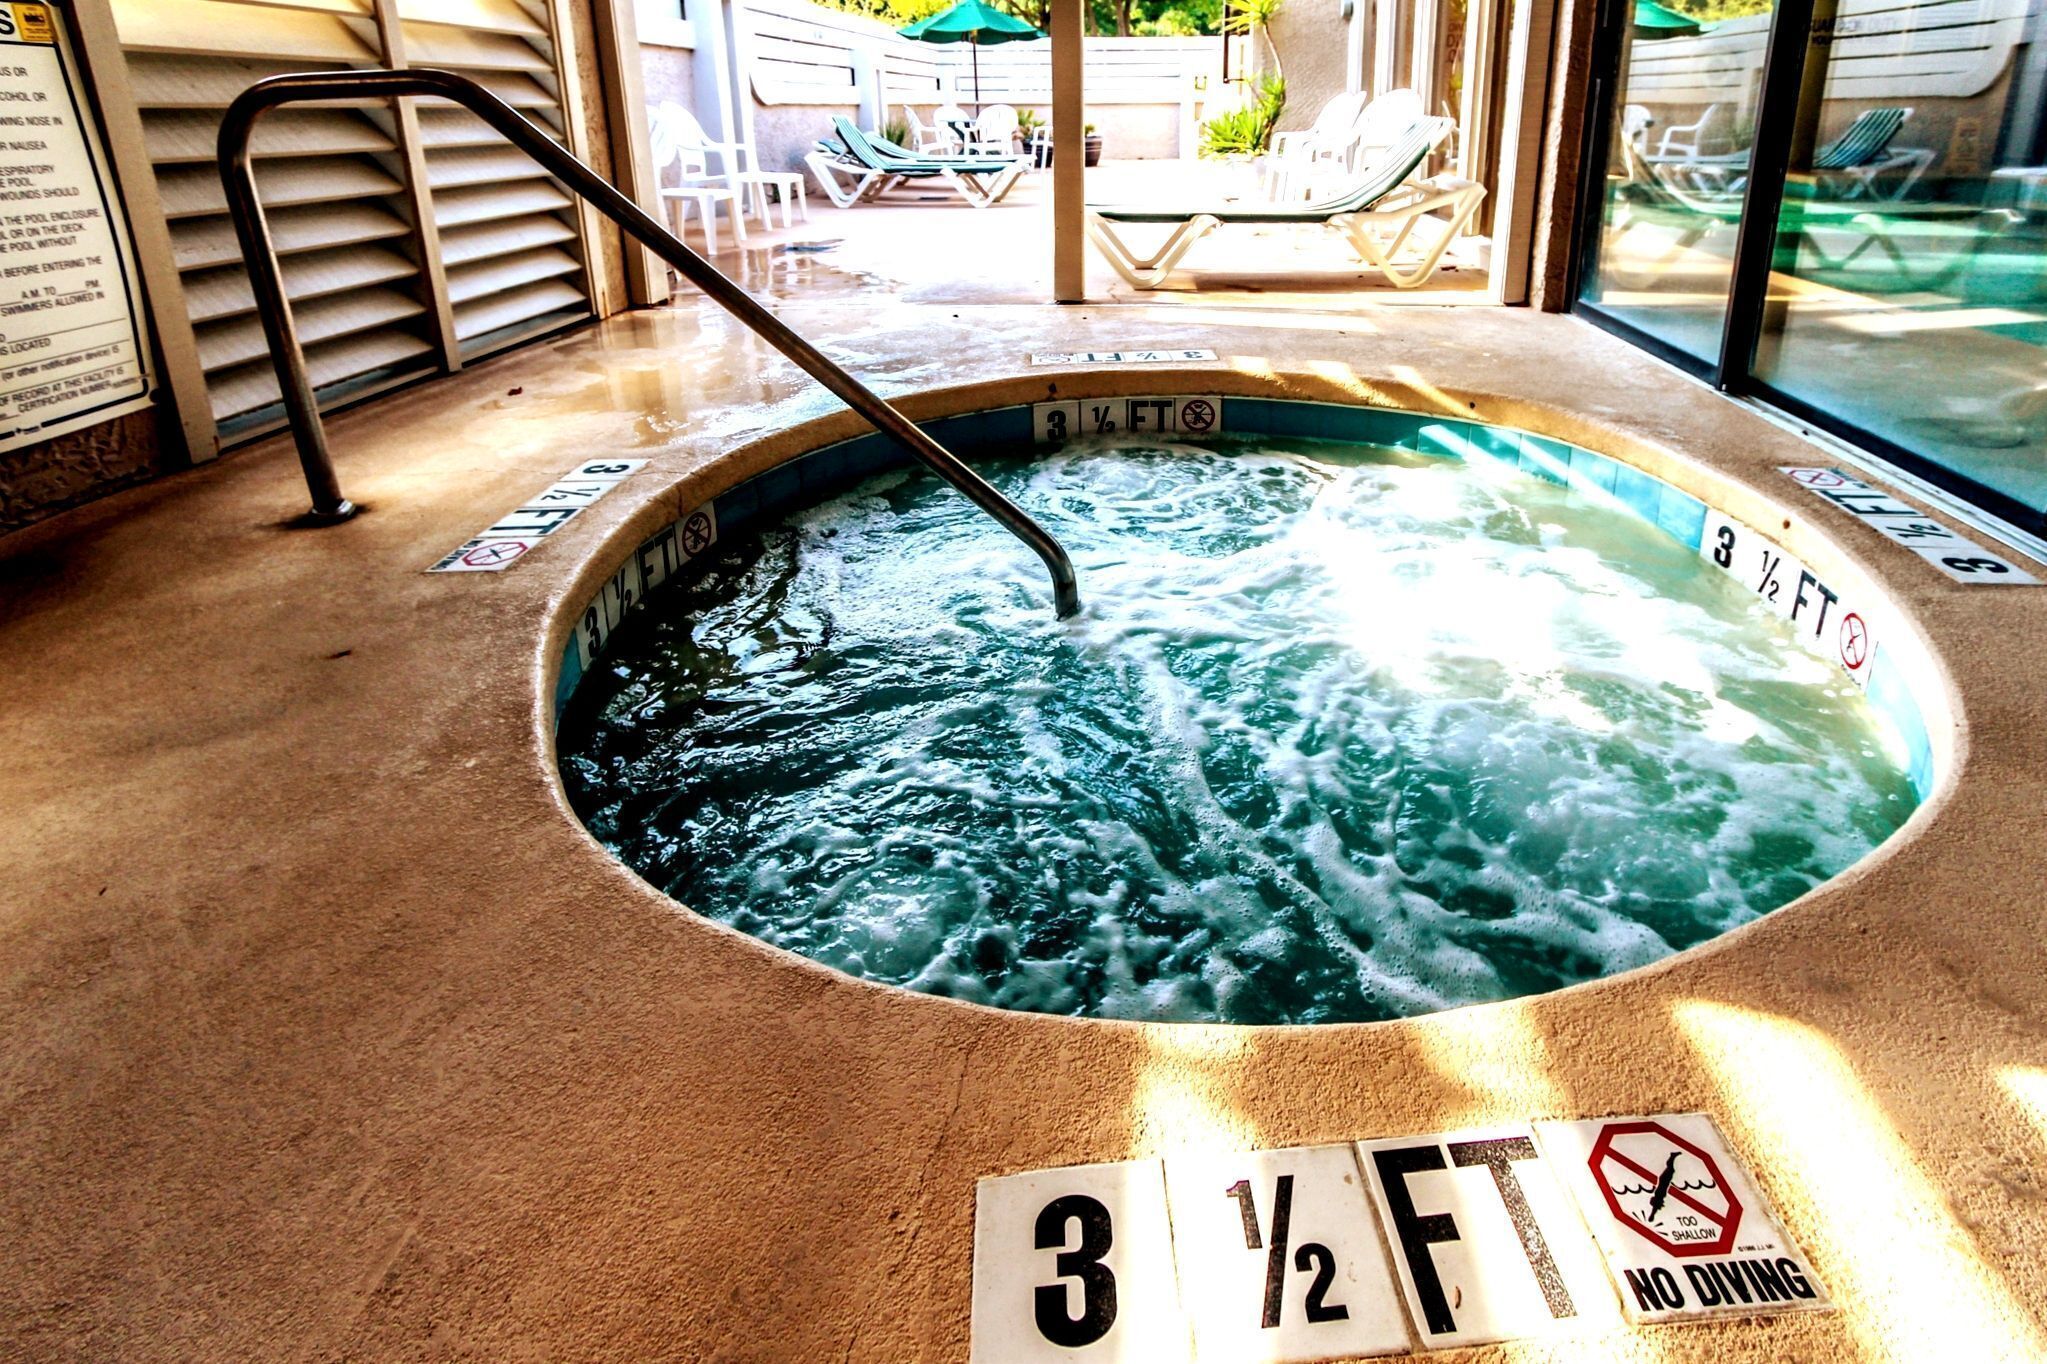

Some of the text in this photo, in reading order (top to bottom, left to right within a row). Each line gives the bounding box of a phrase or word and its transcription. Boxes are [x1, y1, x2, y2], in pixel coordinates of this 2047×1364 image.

[13, 67, 28, 77] OR
[33, 92, 48, 102] OR
[25, 116, 51, 126] NOSE
[9, 141, 48, 150] NAUSEA
[42, 187, 80, 198] SHOULD
[4, 215, 22, 226] THE
[24, 213, 49, 224] POOL
[10, 228, 24, 239] OR
[41, 225, 59, 235] THE
[9, 241, 35, 252] POOL
[37, 235, 77, 248] WITHOUT
[4, 264, 40, 278] BEFORE
[42, 258, 86, 273] ENTERING
[86, 255, 102, 265] THE
[43, 286, 56, 296] TO
[1, 300, 53, 317] SWIMMERS
[55, 292, 94, 306] ALLOWED
[10, 338, 51, 354] LOCATED
[12, 386, 50, 402] RECORD
[18, 389, 79, 413] CERTIFICATION
[1047, 410, 1067, 441] 3
[1130, 400, 1173, 433] FT
[583, 464, 630, 474] 3
[1820, 490, 1918, 515] FT
[489, 508, 579, 535] FT
[638, 527, 674, 596] FT
[1941, 557, 2010, 574] 3
[1713, 525, 1736, 569] 3
[1791, 569, 1839, 637] FT
[1676, 1216, 1698, 1226] TOO
[1033, 1194, 1118, 1348] 3
[1371, 1136, 1579, 1335] FT
[1671, 1228, 1716, 1241] SHALLOW
[1623, 1257, 1818, 1312] NO DIVING
